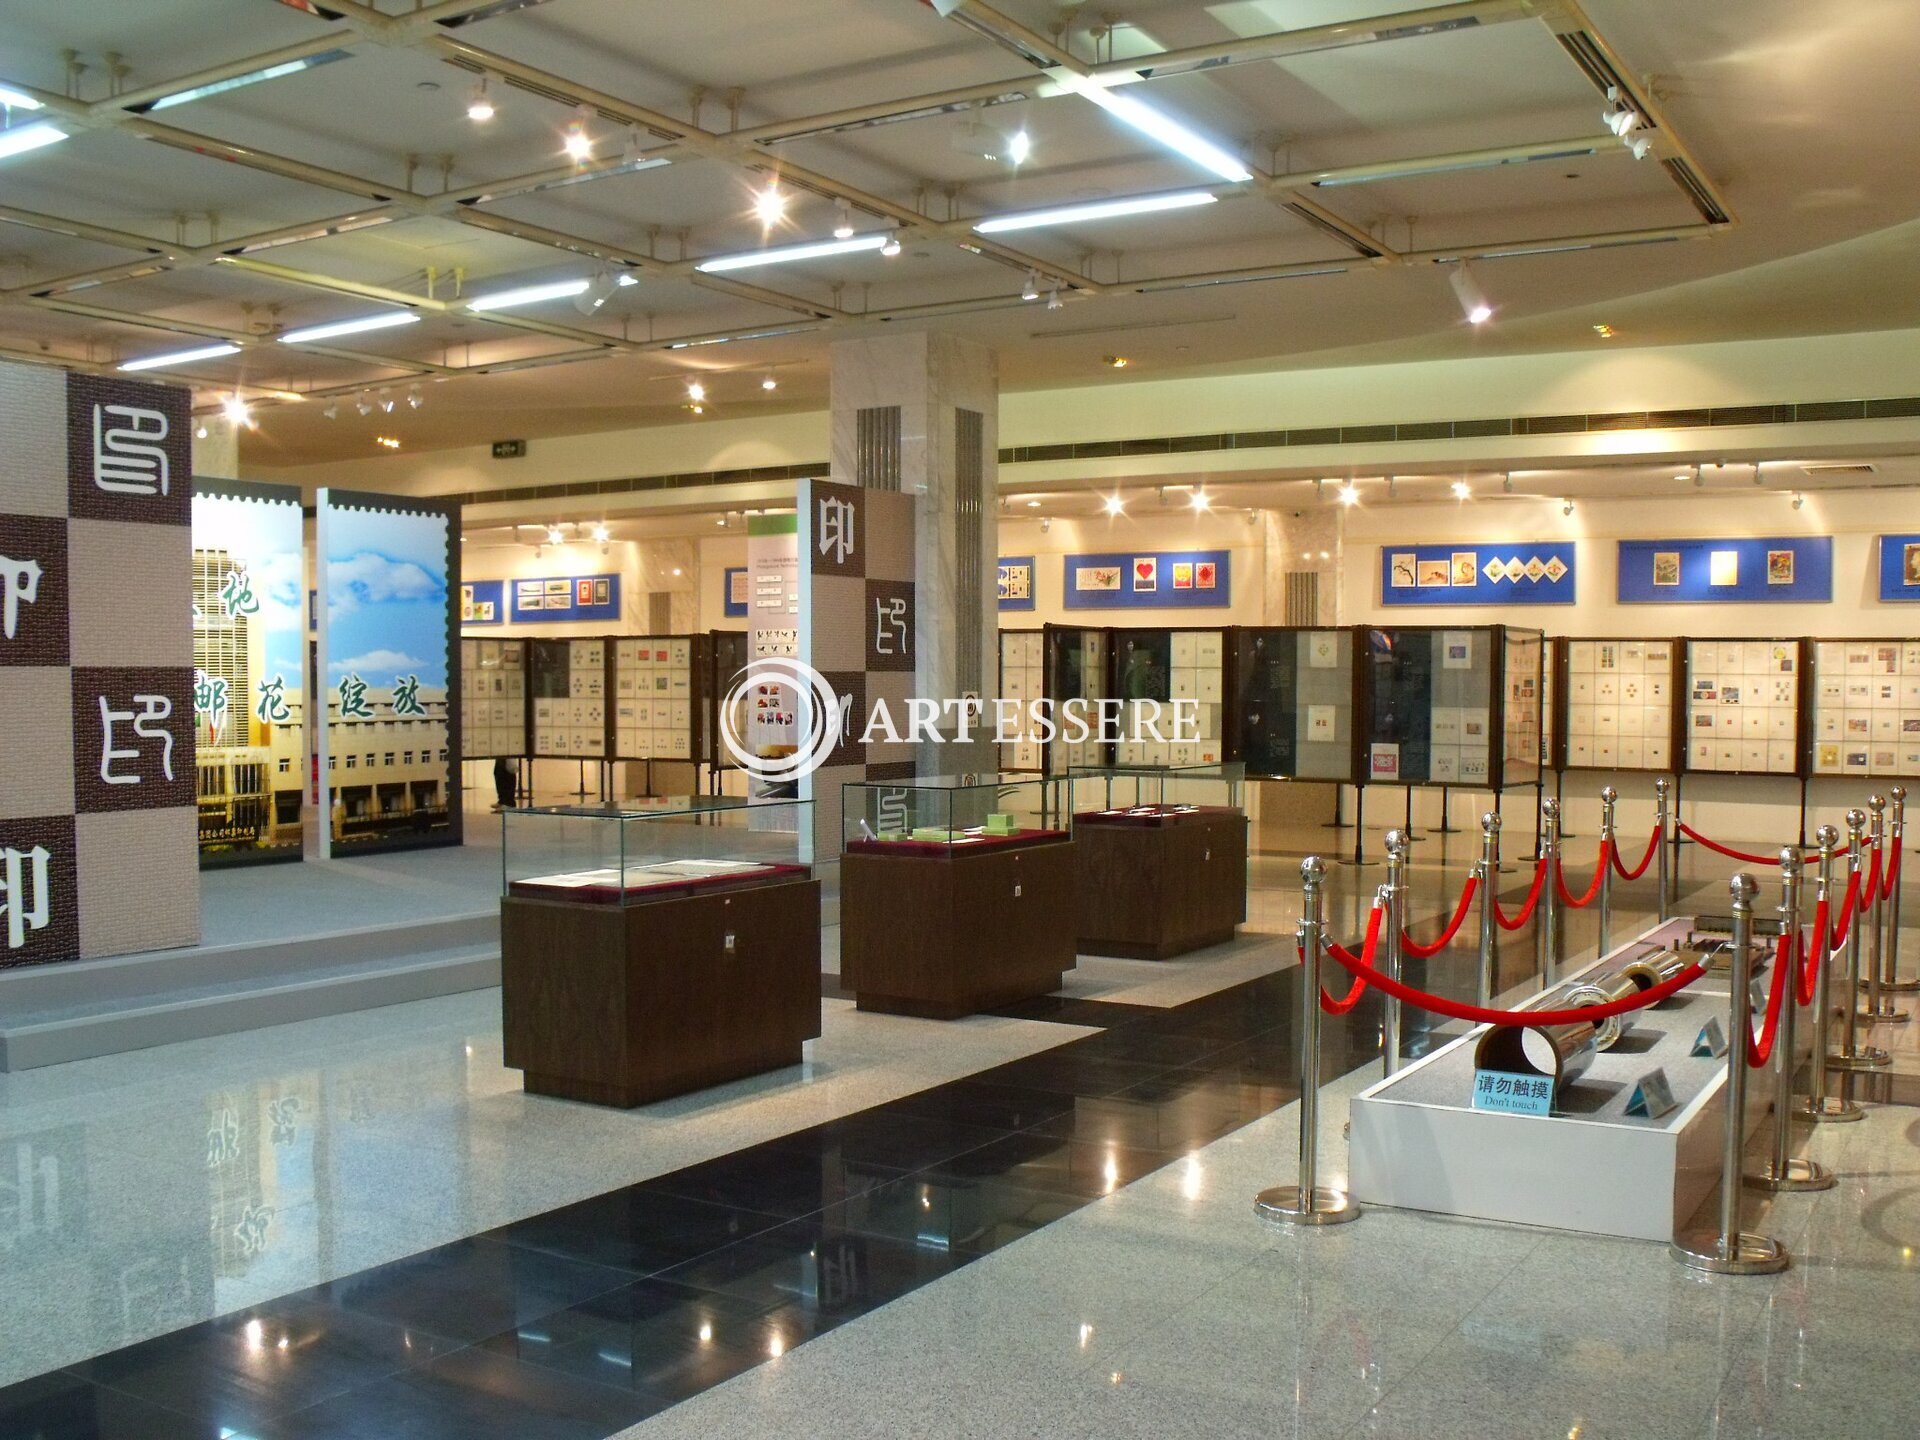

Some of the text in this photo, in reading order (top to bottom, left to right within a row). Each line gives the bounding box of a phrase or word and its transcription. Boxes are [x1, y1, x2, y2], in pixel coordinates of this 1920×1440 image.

[819, 496, 855, 565] 印
[339, 673, 426, 718] 绽放
[1478, 1075, 1548, 1099] 请勿触摸
[1484, 1096, 1538, 1110] Don't touch
